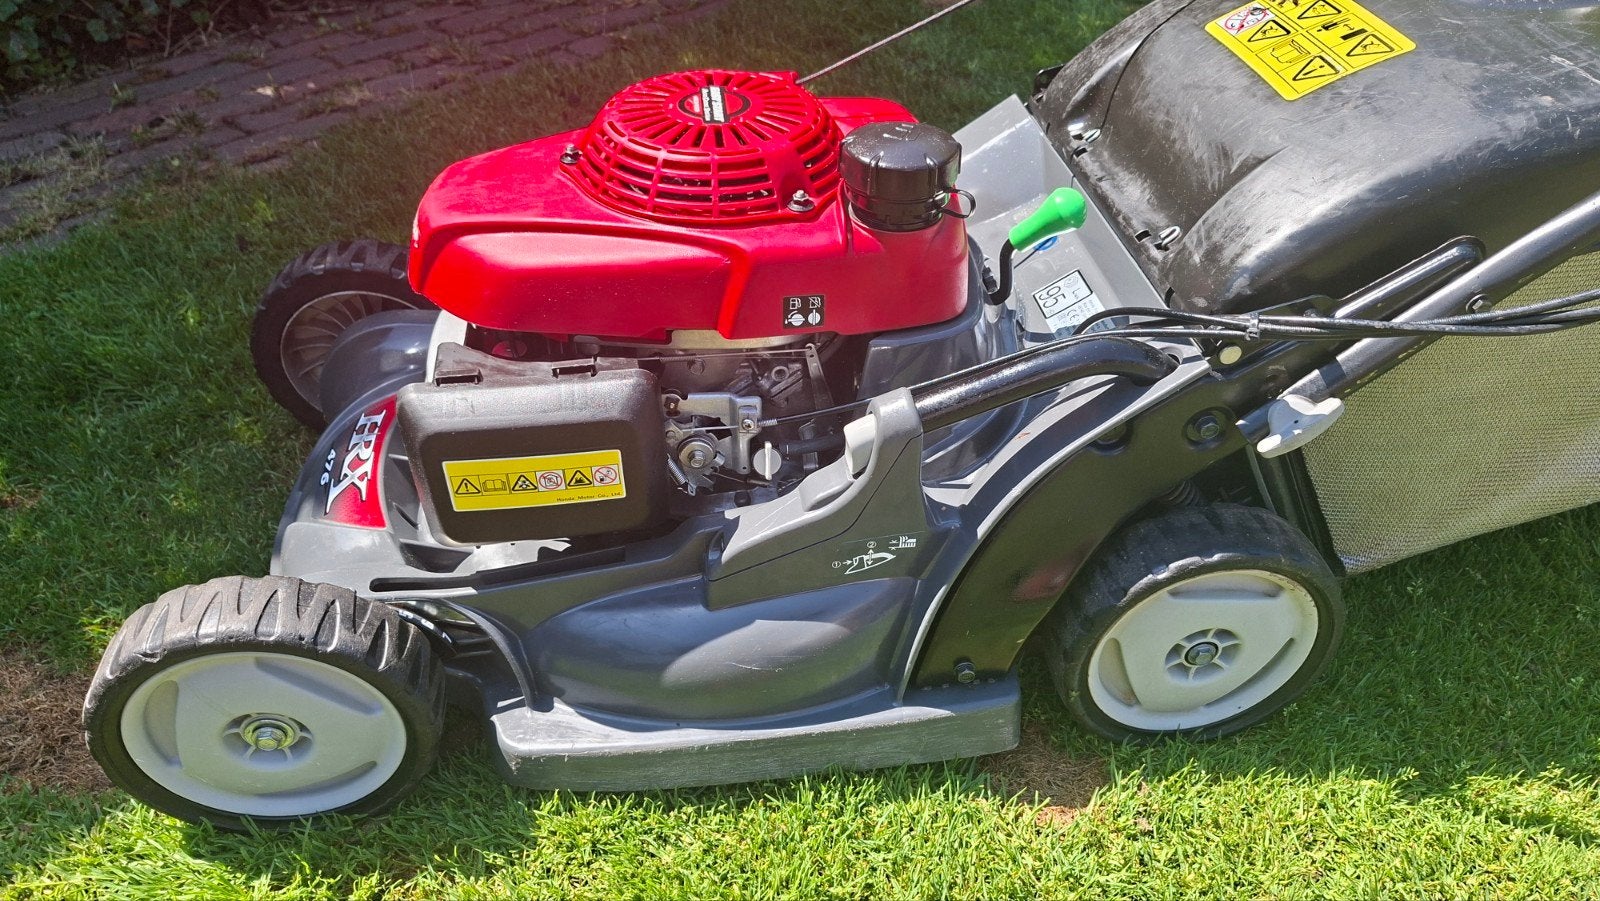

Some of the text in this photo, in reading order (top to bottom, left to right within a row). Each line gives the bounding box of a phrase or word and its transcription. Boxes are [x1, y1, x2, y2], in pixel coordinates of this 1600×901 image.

[1039, 286, 1066, 308] 95
[320, 449, 336, 486] 476
[325, 410, 386, 514] HRX
